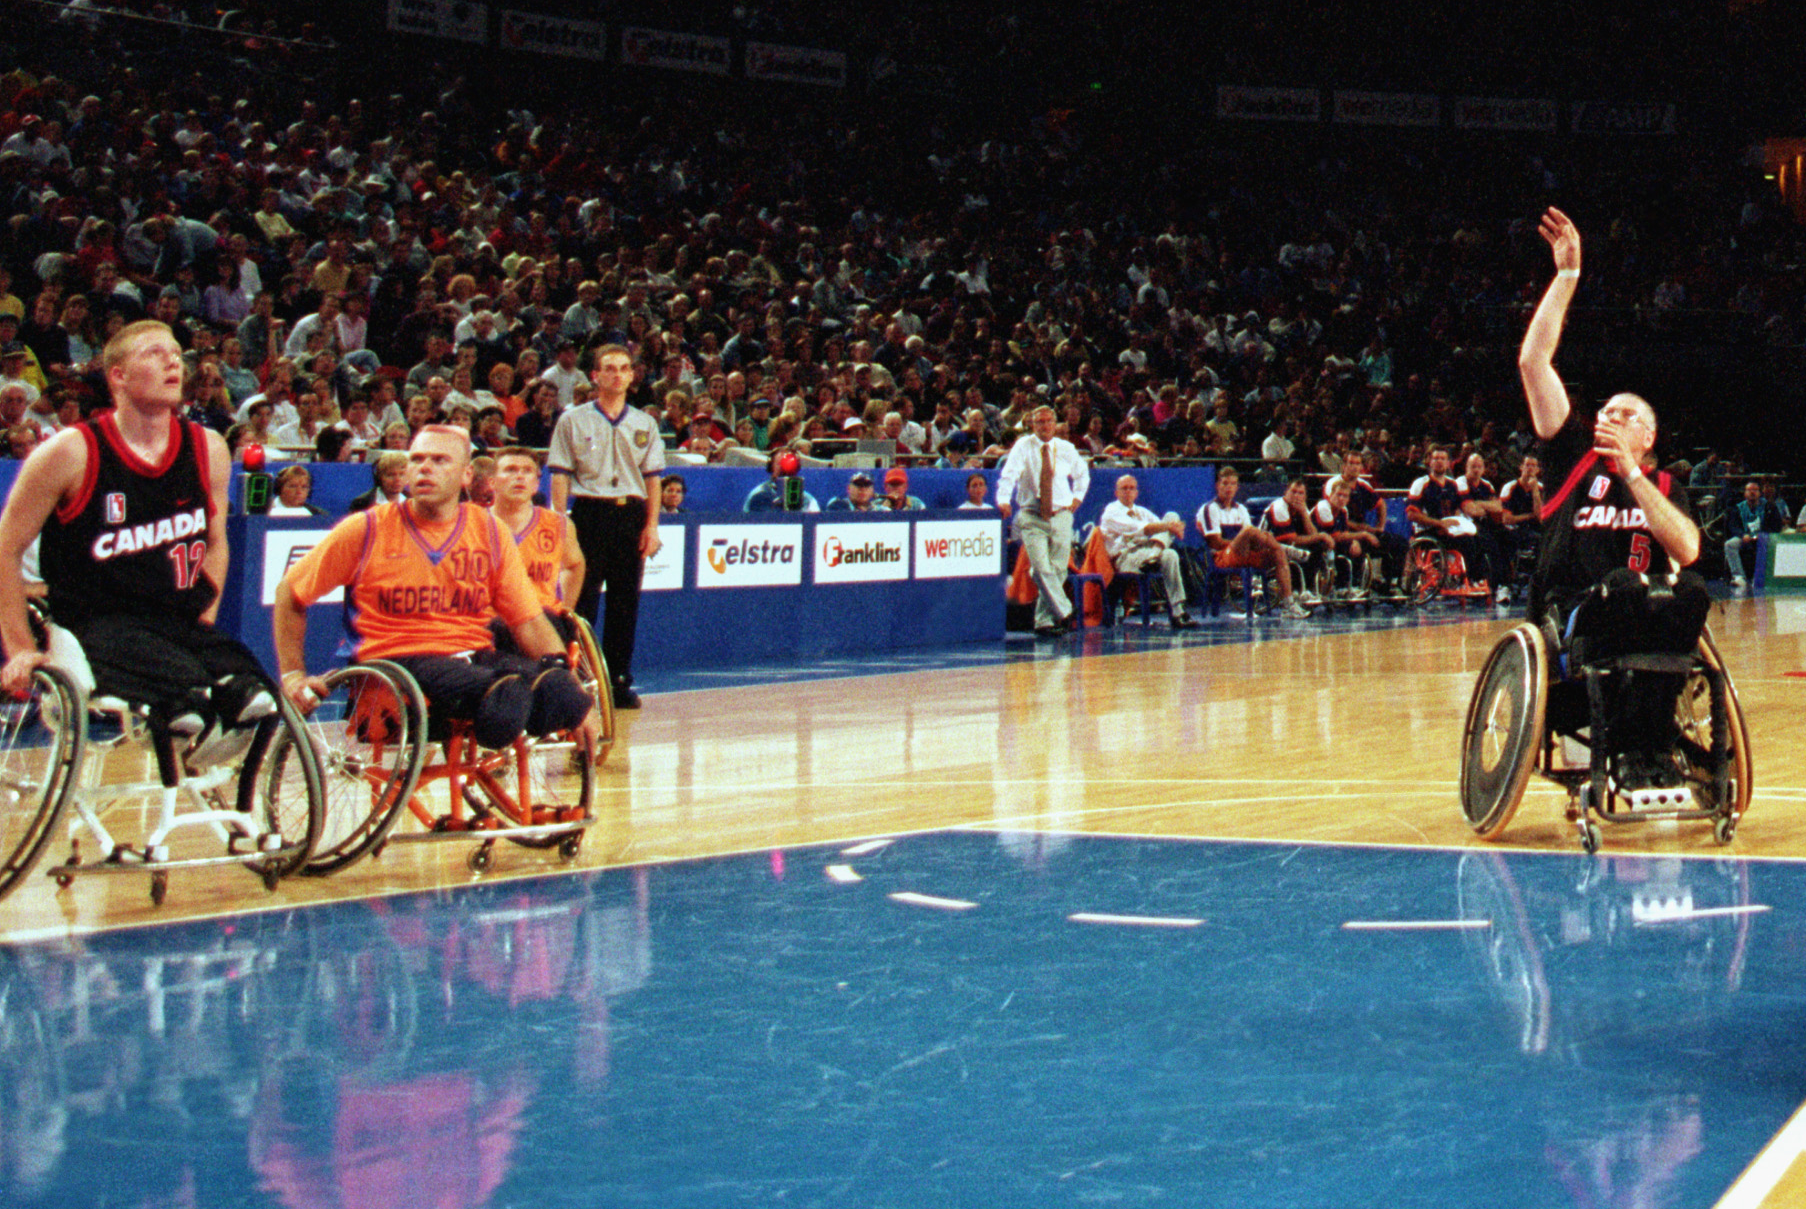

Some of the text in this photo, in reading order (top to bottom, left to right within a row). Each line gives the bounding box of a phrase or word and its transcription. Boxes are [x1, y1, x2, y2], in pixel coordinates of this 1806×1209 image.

[93, 507, 206, 559] CANADA
[1573, 505, 1650, 529] CANAD
[538, 529, 555, 553] 6
[707, 538, 795, 574] Telstra
[823, 536, 901, 567] Franklins
[925, 531, 993, 558] wemedia
[1628, 532, 1651, 573] 5
[451, 547, 491, 582] 10
